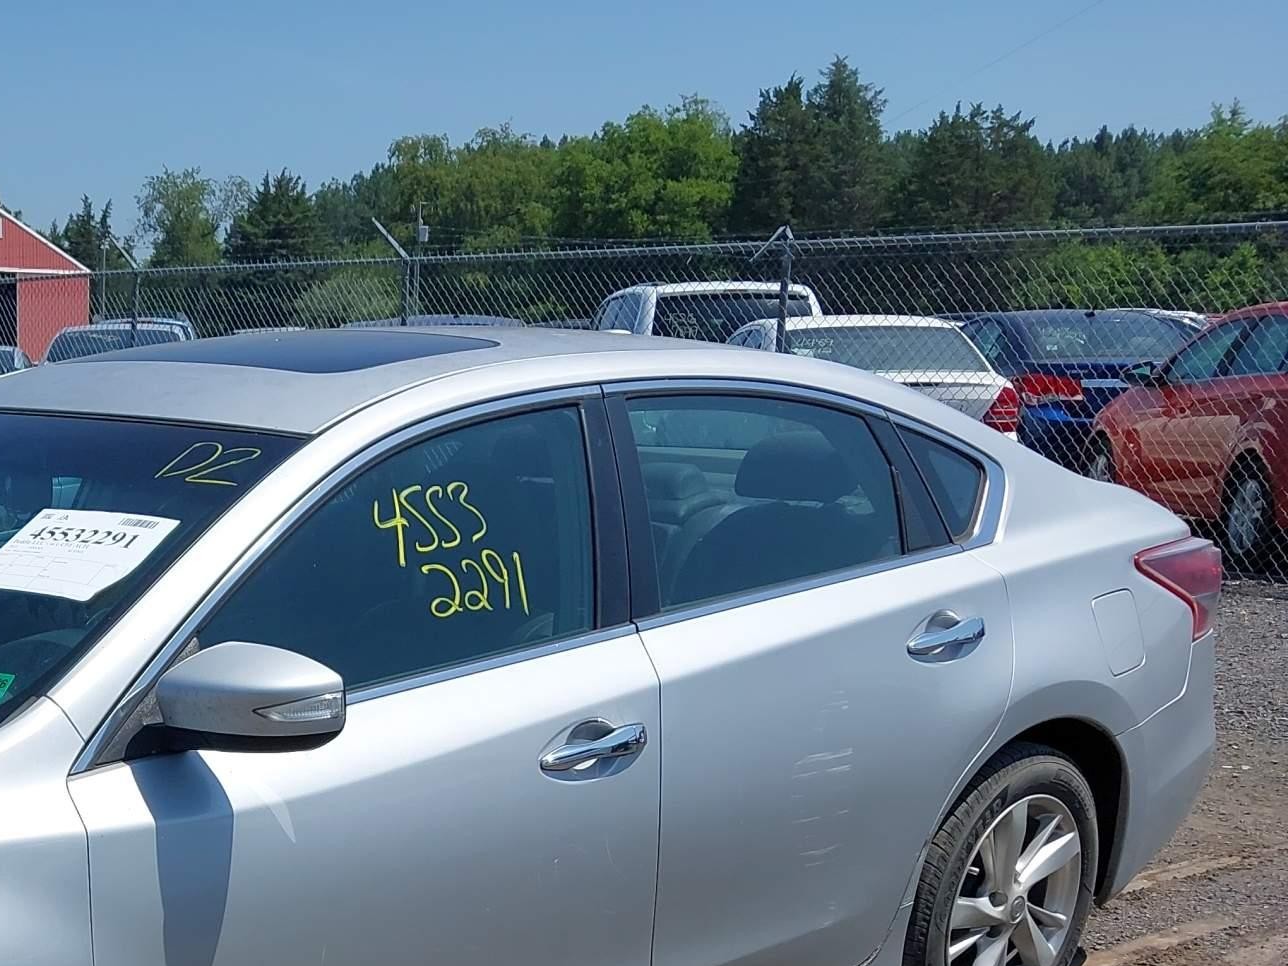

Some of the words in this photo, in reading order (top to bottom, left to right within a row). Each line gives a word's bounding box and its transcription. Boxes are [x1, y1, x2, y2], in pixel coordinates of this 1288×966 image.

[153, 441, 262, 487] D2
[29, 525, 141, 549] 45532291
[372, 481, 488, 568] 4553
[421, 549, 530, 618] 2291
